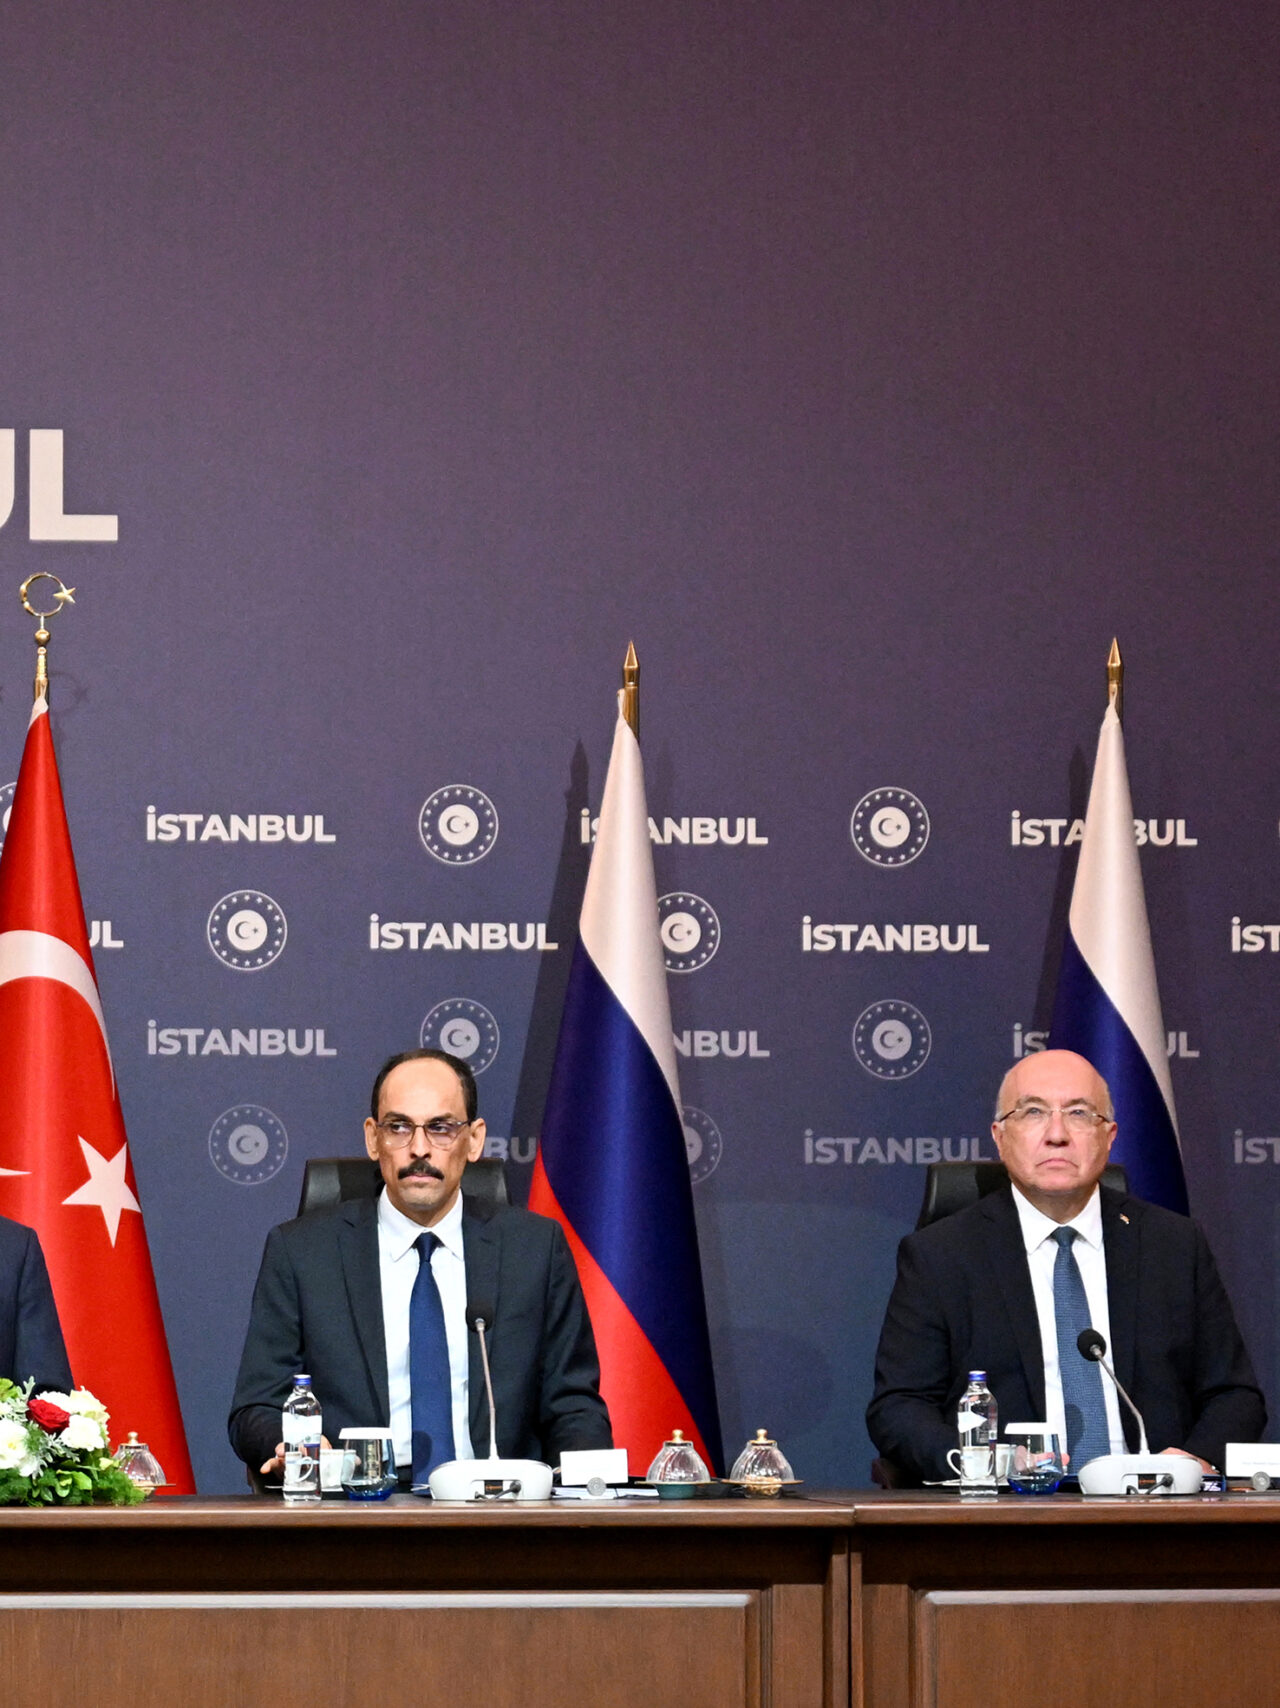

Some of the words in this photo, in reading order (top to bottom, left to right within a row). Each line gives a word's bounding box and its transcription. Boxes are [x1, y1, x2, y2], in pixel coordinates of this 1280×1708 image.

[146, 804, 337, 843] İSTANBUL
[369, 913, 559, 951] İSTANBUL
[802, 915, 990, 952] İSTANBUL
[147, 1019, 337, 1056] İSTANBUL
[804, 1128, 991, 1165] İSTANBUL
